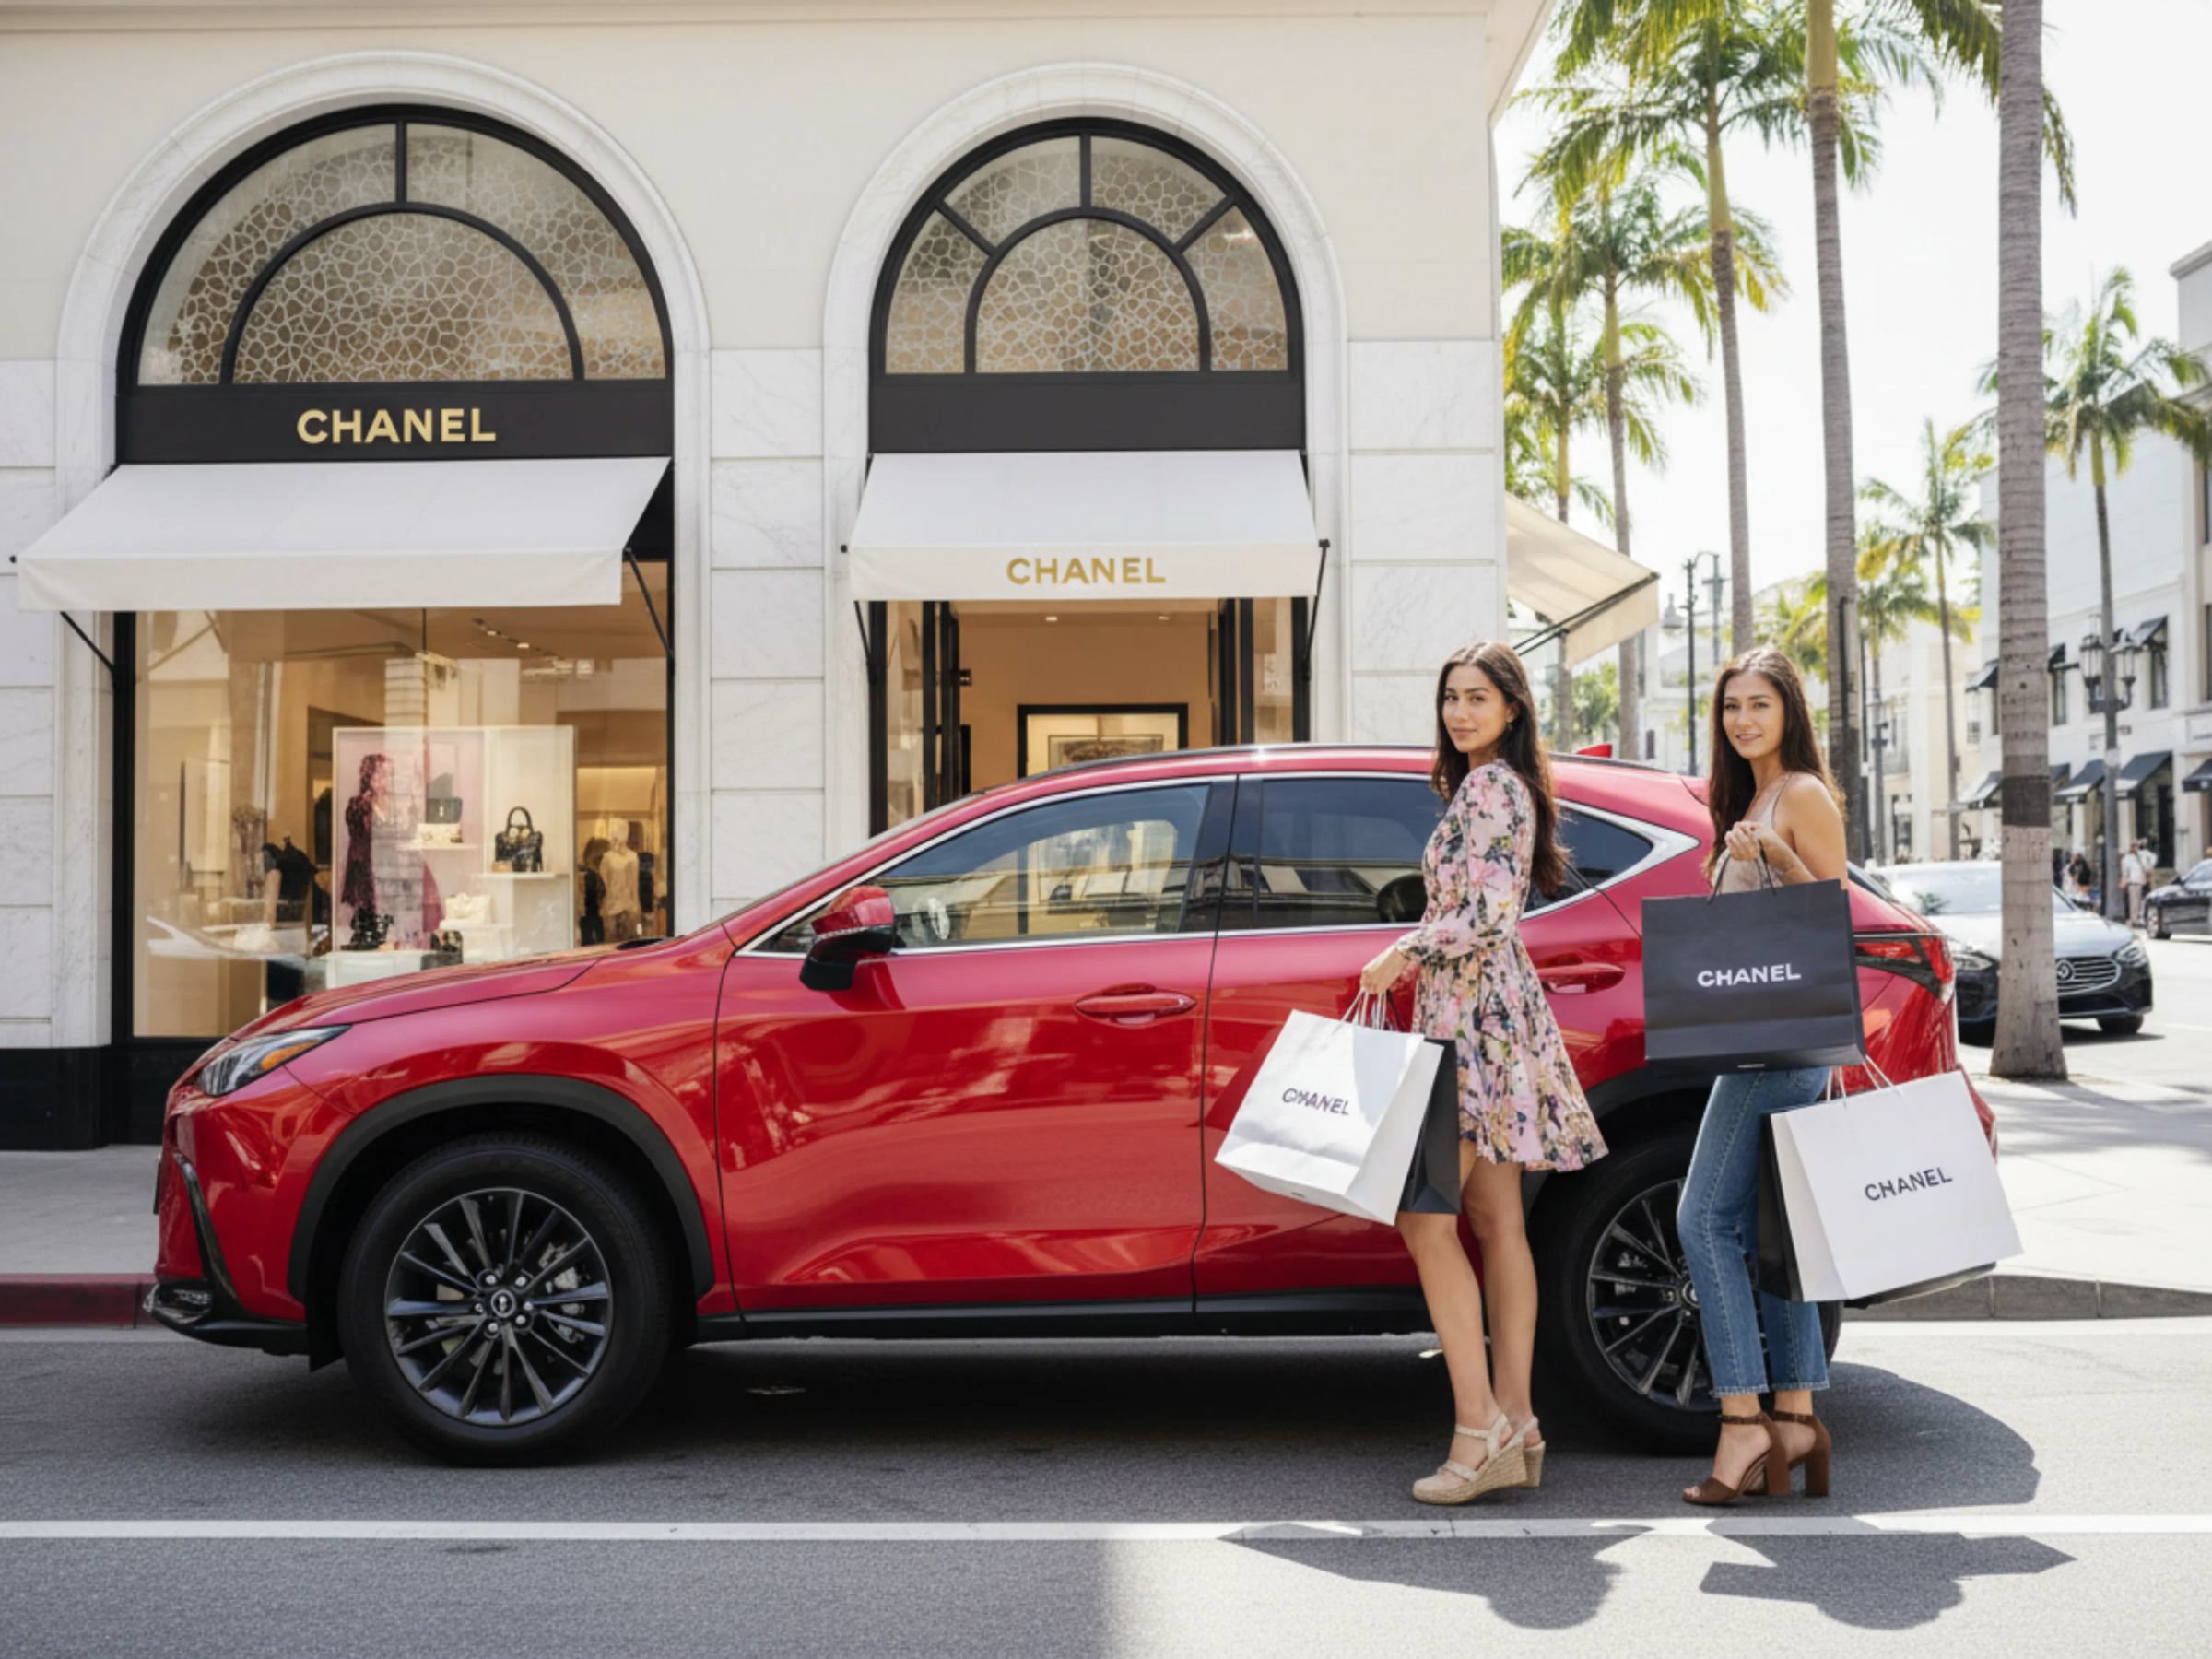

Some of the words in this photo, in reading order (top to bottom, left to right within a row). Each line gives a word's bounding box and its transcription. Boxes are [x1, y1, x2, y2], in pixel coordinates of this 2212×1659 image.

[297, 407, 497, 444] CHANEL
[1006, 557, 1167, 585] CHANEL
[1697, 963, 1802, 987] CHANEL
[1865, 1167, 1953, 1201] CHANEL
